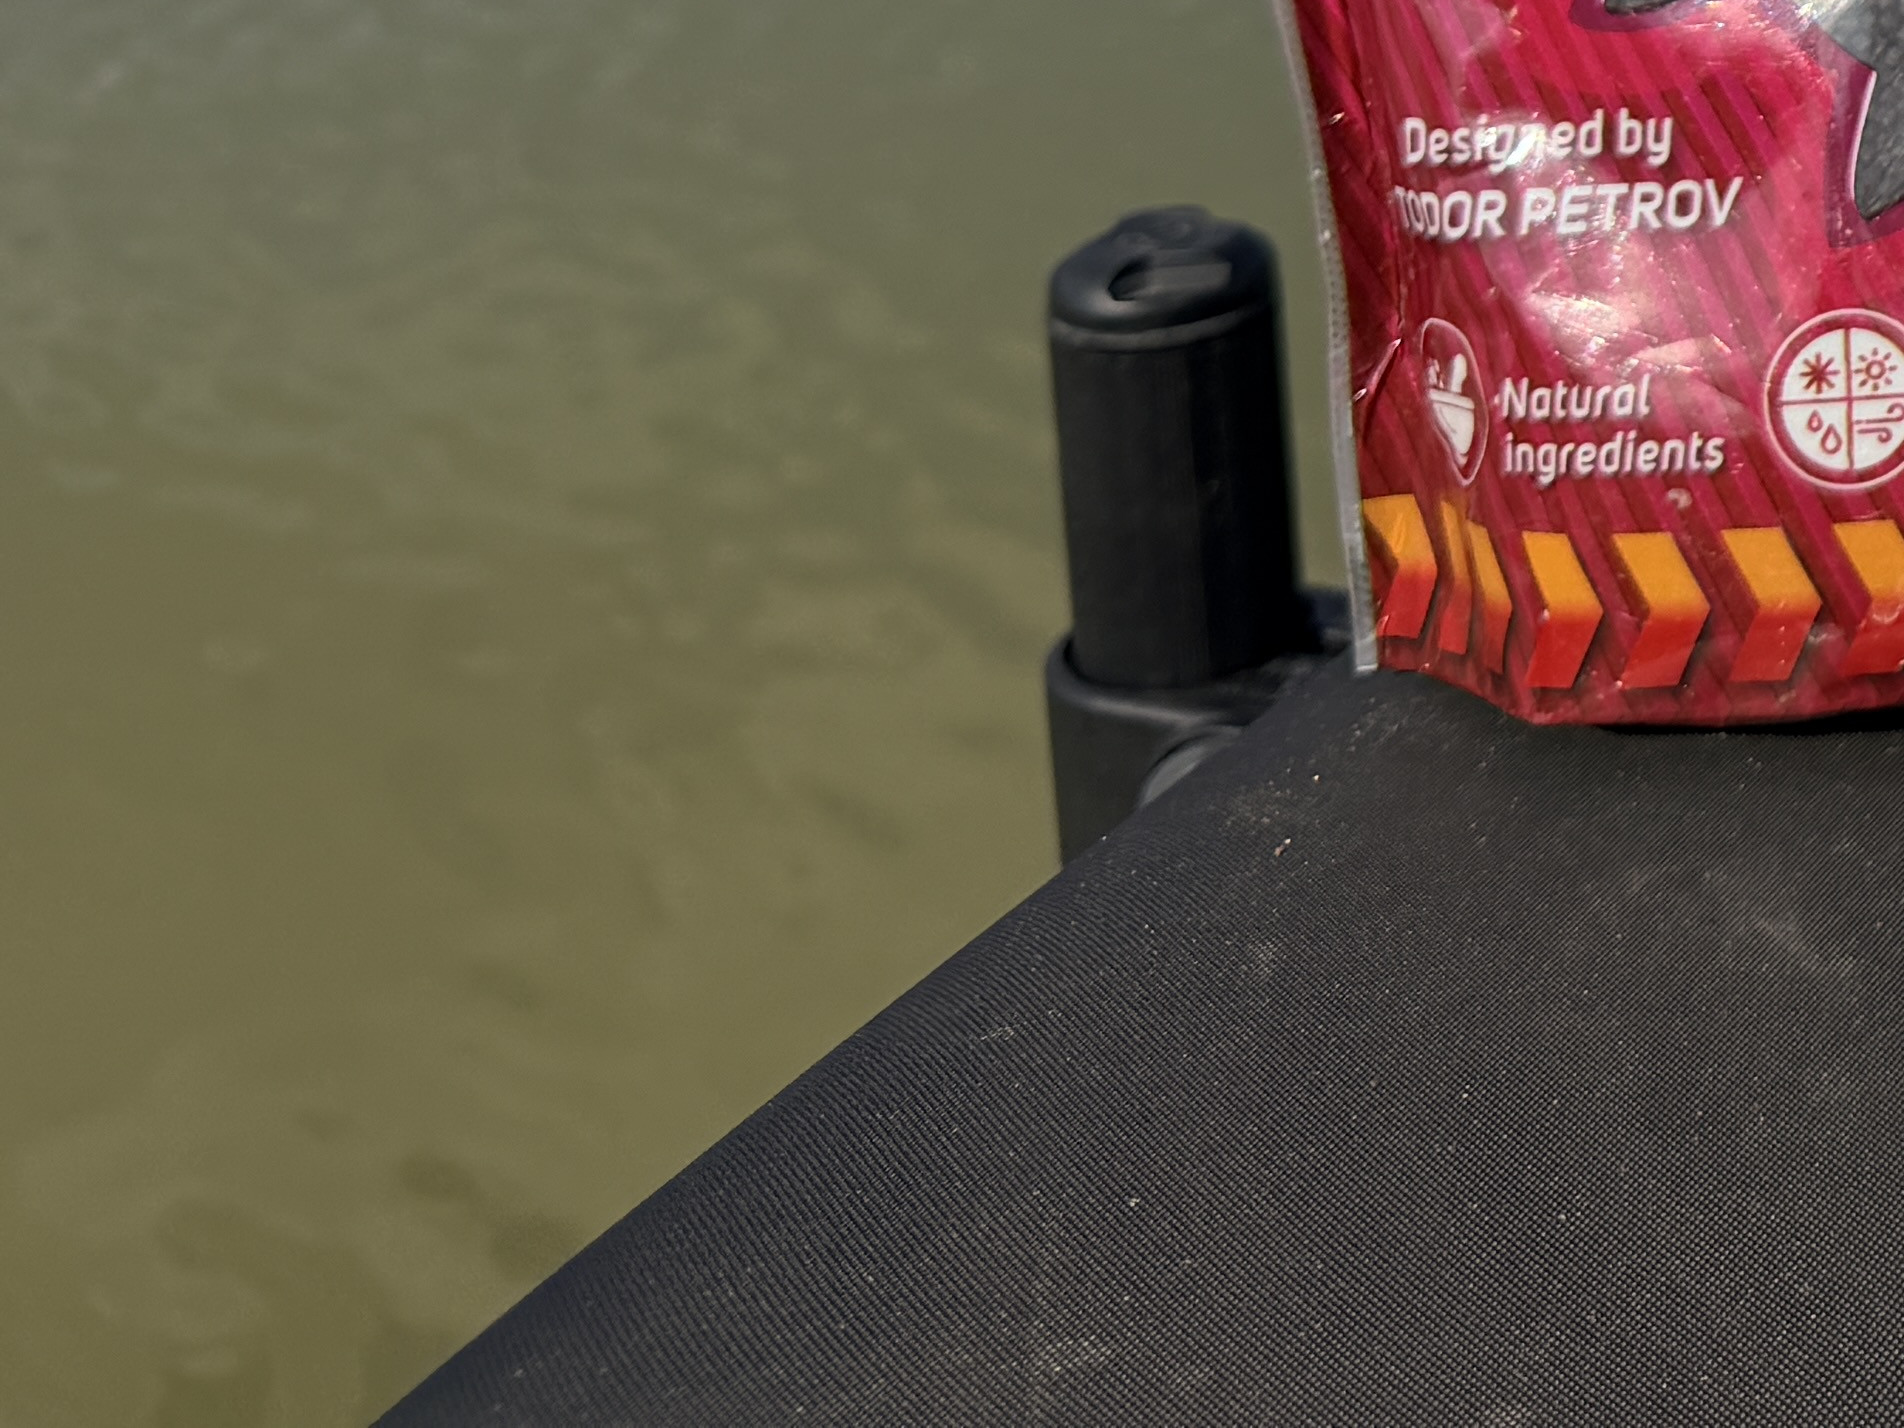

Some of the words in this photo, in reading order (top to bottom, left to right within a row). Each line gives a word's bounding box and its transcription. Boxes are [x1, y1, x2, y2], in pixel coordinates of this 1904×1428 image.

[1403, 108, 1605, 174] Designed
[1617, 106, 1674, 168] by
[1395, 186, 1508, 240] TODOR
[1517, 176, 1744, 236] PETROV
[1501, 373, 1651, 420] Natural
[1503, 430, 1726, 489] ingredients
